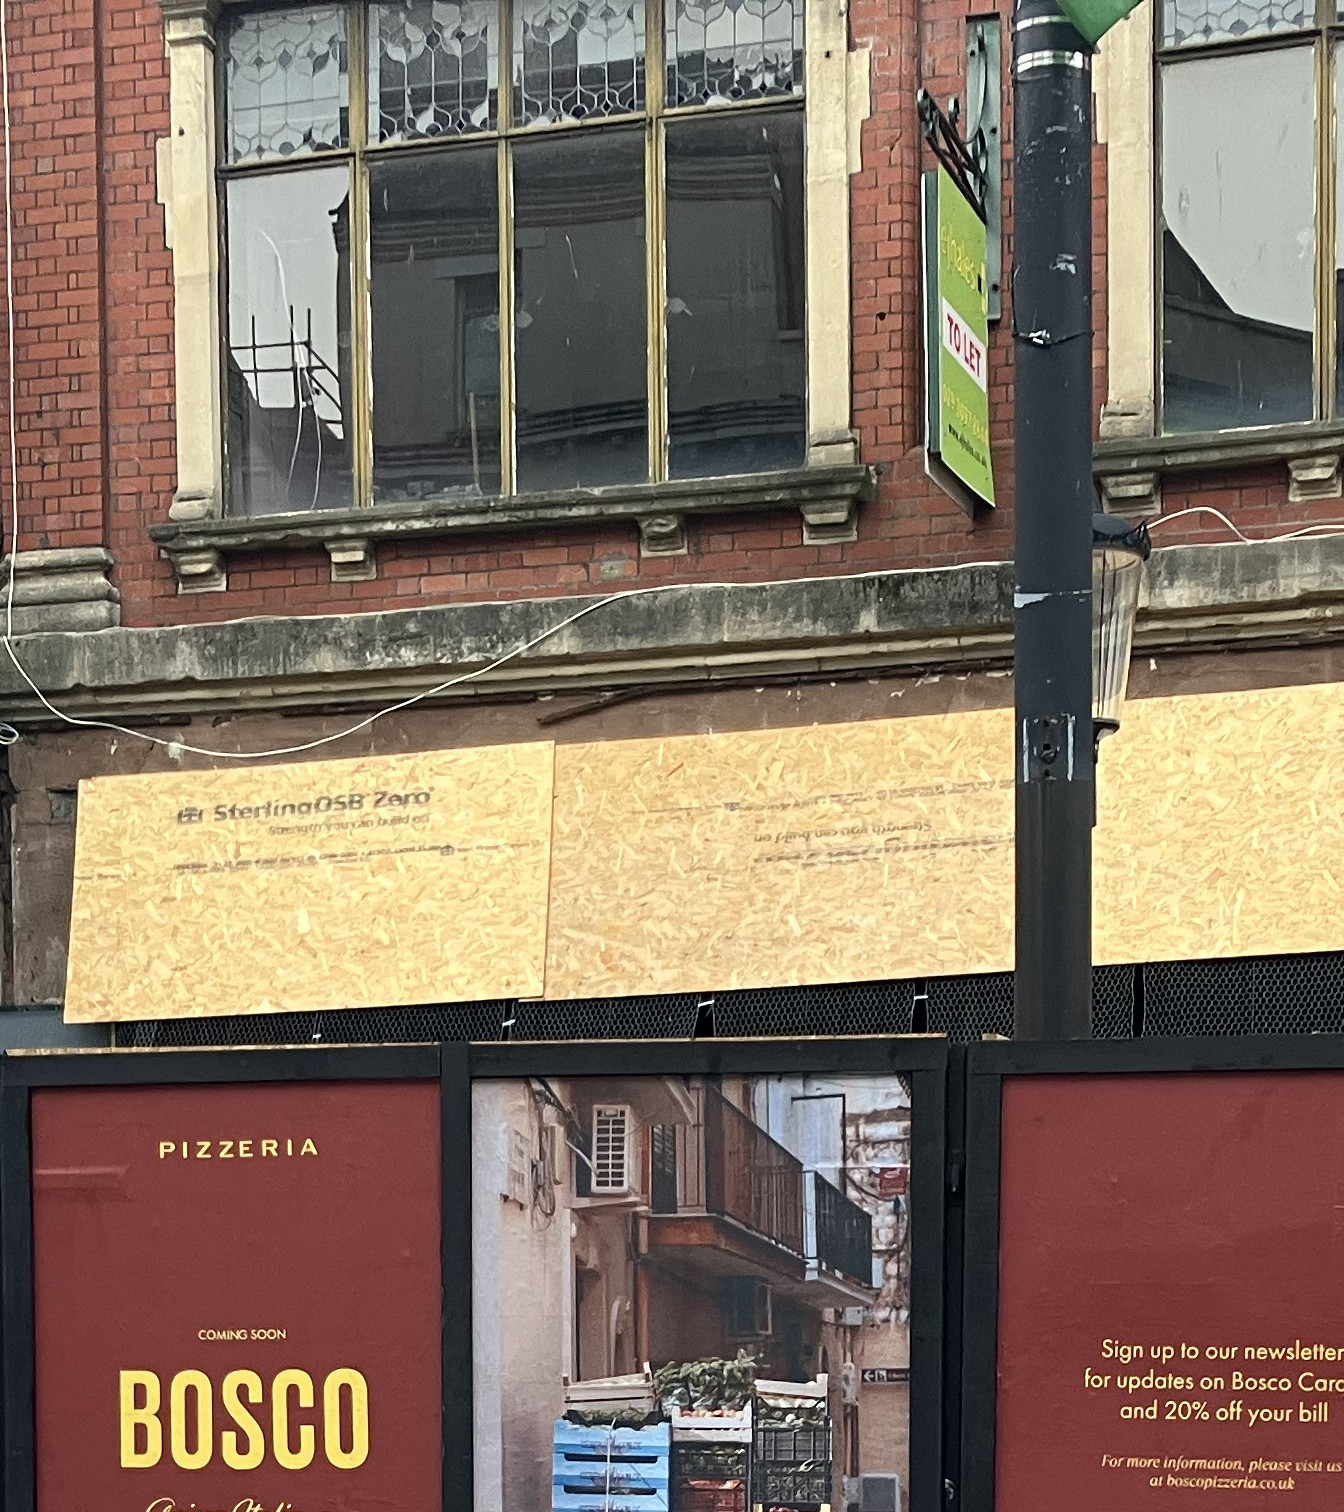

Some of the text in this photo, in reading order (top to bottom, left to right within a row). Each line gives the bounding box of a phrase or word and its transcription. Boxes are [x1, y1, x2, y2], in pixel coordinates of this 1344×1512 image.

[947, 312, 981, 378] TO LET
[159, 1138, 319, 1159] PIZZERIA
[198, 1328, 287, 1341] COMING SOON
[1101, 1338, 1144, 1364] Sign
[1150, 1345, 1175, 1364] up
[1181, 1341, 1199, 1360] to
[1205, 1345, 1239, 1361] our
[1084, 1367, 1112, 1389] for
[1116, 1368, 1195, 1393] updates
[1199, 1375, 1225, 1391] on
[1232, 1371, 1293, 1392] Bosco
[119, 1368, 370, 1471] BOSCO
[1120, 1399, 1329, 1428] and 20% off your bill
[1101, 1453, 1343, 1474] For more information, please visit us
[1149, 1473, 1296, 1491] at boscopizzeria.co.uk
